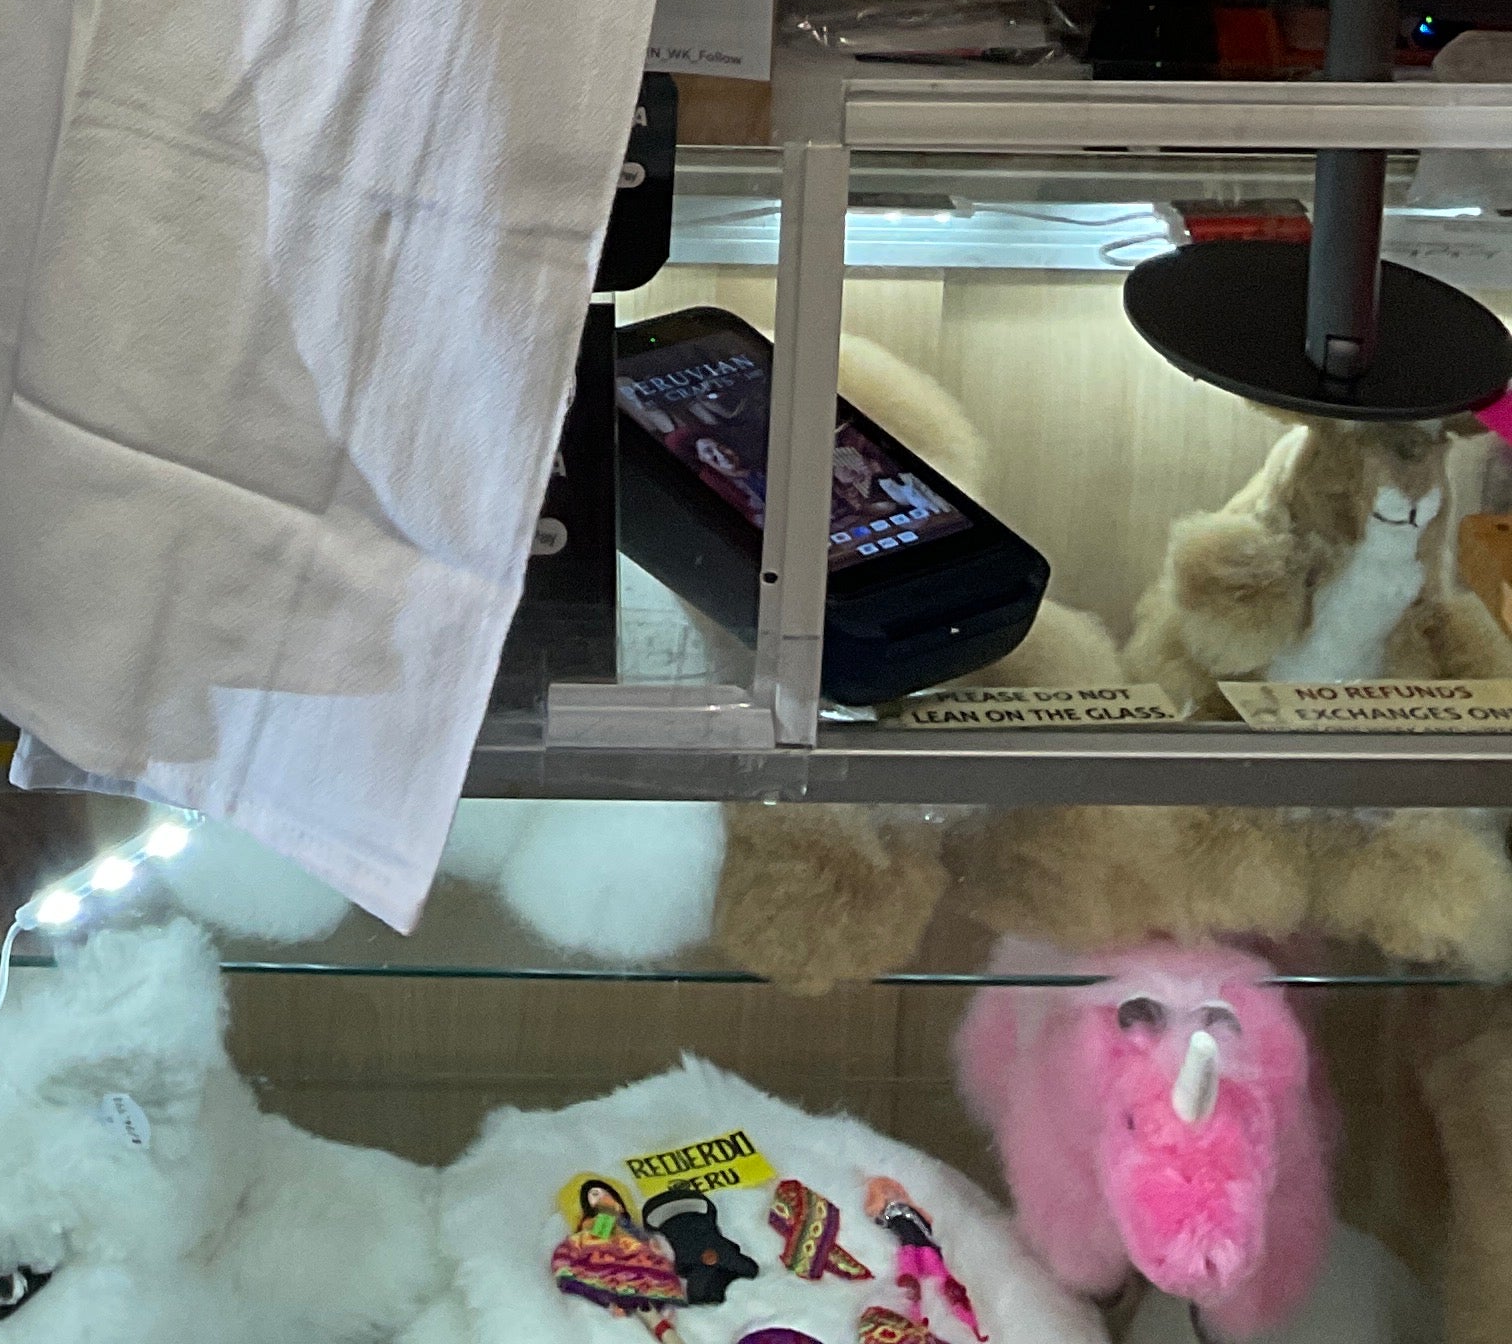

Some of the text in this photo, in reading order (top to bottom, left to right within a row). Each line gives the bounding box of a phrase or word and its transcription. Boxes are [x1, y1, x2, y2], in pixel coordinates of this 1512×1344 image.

[617, 353, 755, 400] PERUVIAN
[938, 686, 1131, 703] PLEASE DO NOT
[1294, 684, 1474, 701] NO REFUNDS
[911, 706, 1176, 724] LEAN ON THE GLASS.
[1294, 706, 1464, 722] EXCHANGES
[625, 1130, 757, 1180] RECUERDO
